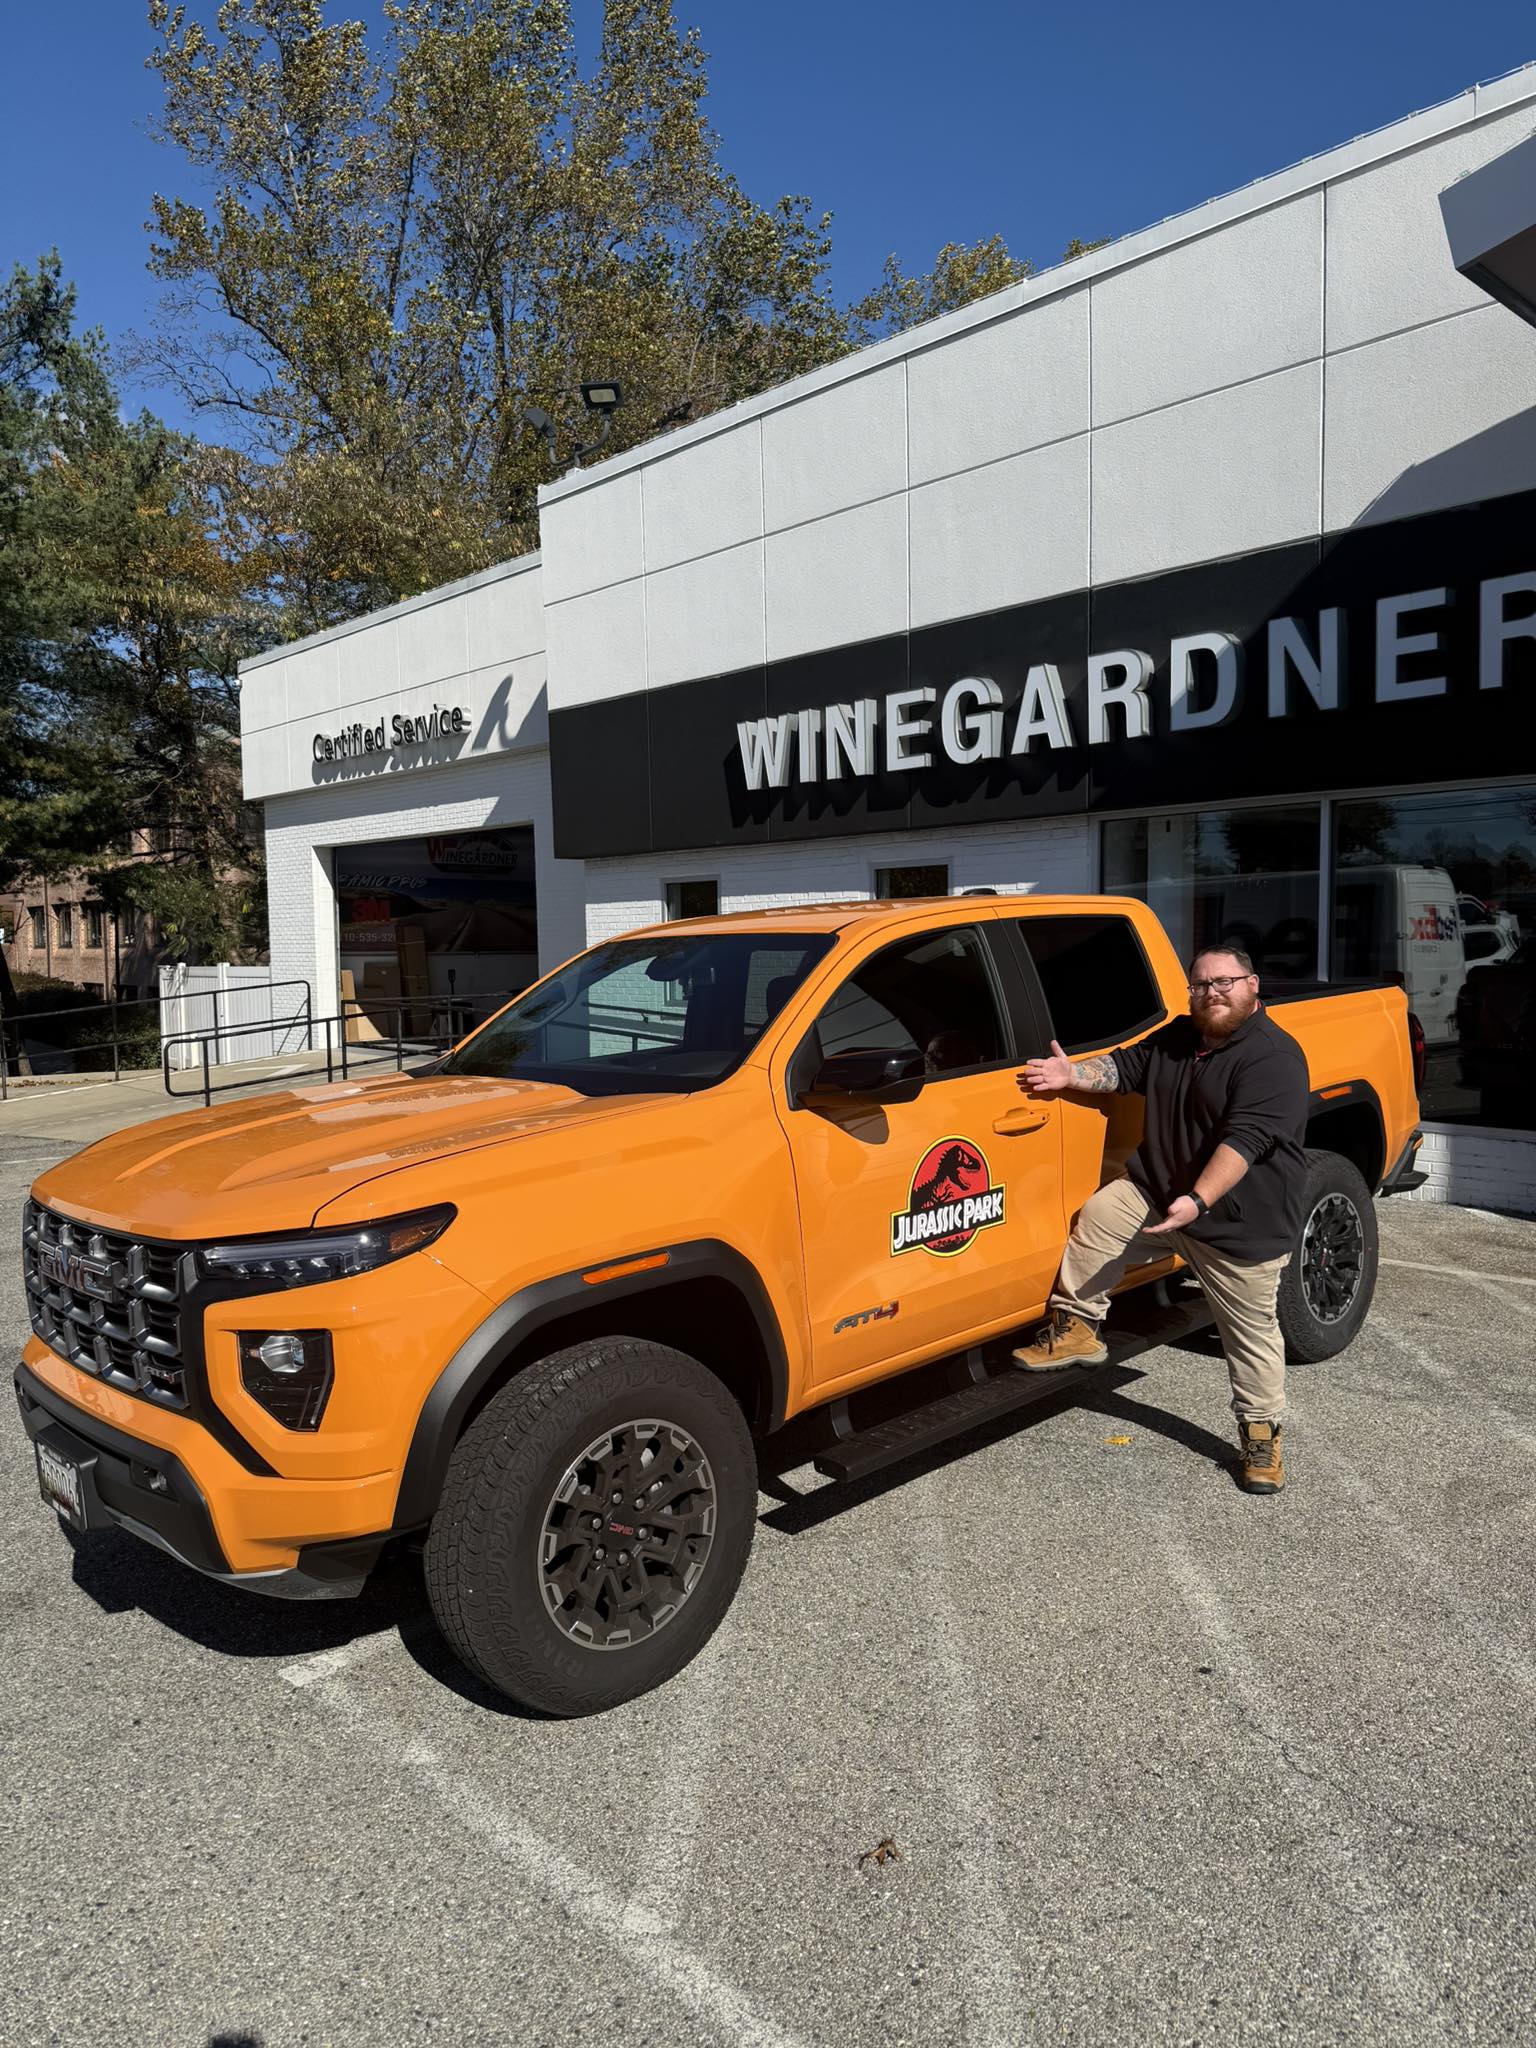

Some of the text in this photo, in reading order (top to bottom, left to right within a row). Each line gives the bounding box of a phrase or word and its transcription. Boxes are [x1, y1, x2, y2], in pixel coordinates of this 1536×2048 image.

[737, 570, 1536, 791] WINEGARDNER
[313, 703, 465, 763] Certified Service
[427, 837, 518, 866] WINEGARDNER
[893, 1192, 1003, 1249] JURASSIC PARK
[39, 1240, 113, 1303] GMC
[833, 1299, 899, 1335] AT4
